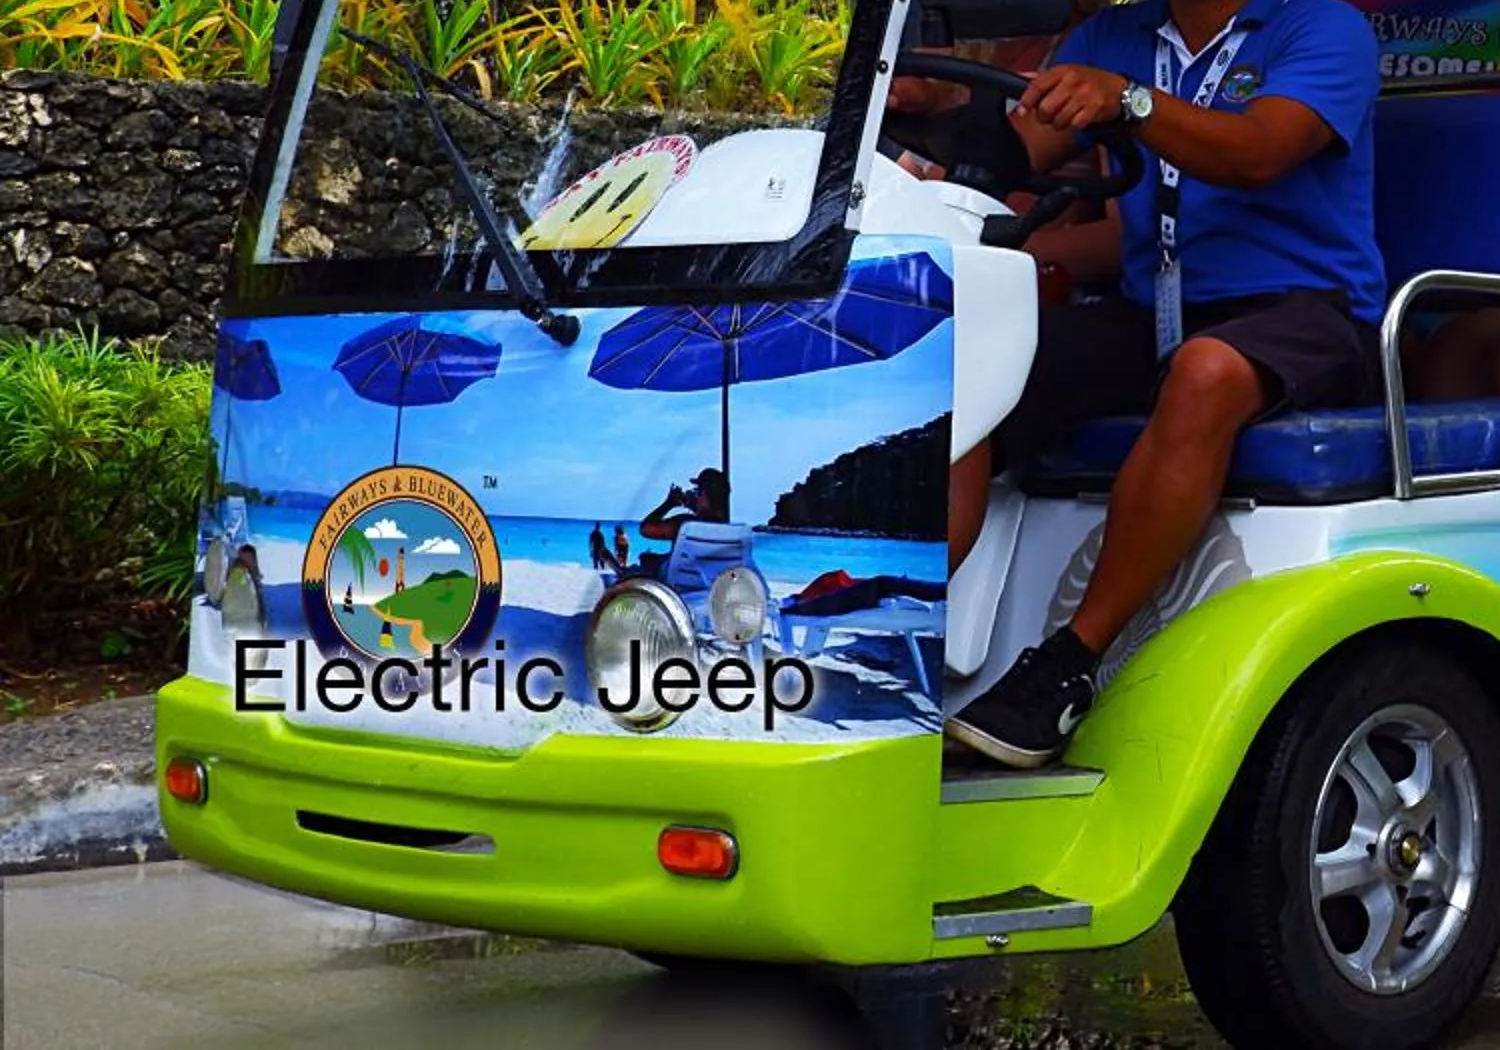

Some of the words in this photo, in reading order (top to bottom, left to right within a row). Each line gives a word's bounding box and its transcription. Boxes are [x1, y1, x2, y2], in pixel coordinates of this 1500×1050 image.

[1369, 12, 1488, 46] RWAYS
[319, 478, 387, 550] FAIRWAYS
[393, 476, 402, 493] &
[409, 476, 487, 548] BLUEWATER
